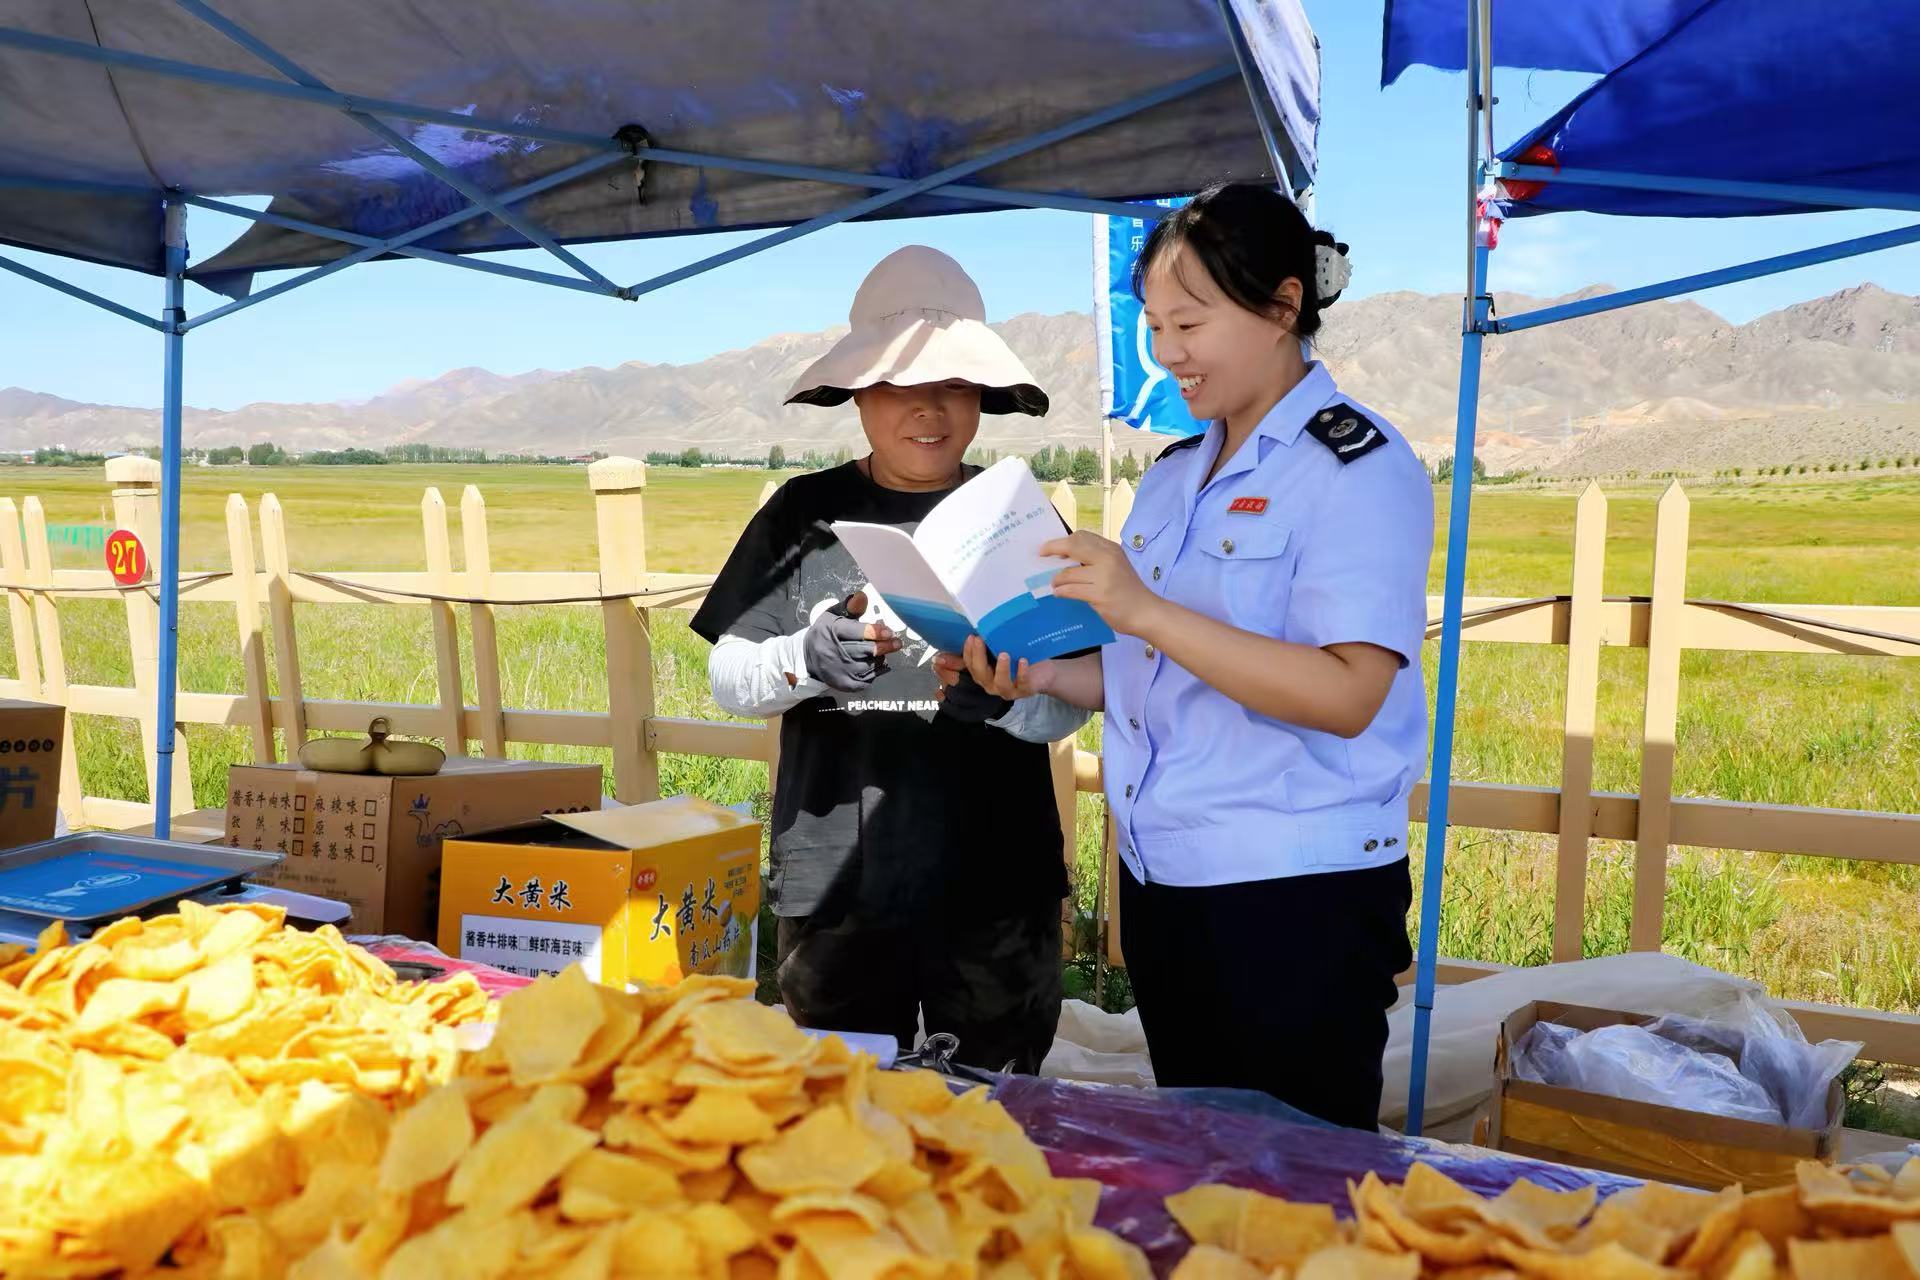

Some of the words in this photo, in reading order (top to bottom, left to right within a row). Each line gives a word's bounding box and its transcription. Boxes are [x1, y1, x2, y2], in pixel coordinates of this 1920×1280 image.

[111, 539, 137, 575] 27
[847, 700, 905, 711] PEACHEAT
[492, 876, 573, 911] 大黄米
[650, 879, 718, 941] 大黄米
[465, 930, 518, 951] 酱香牛排味
[528, 935, 583, 957] 鲜虾海苔味
